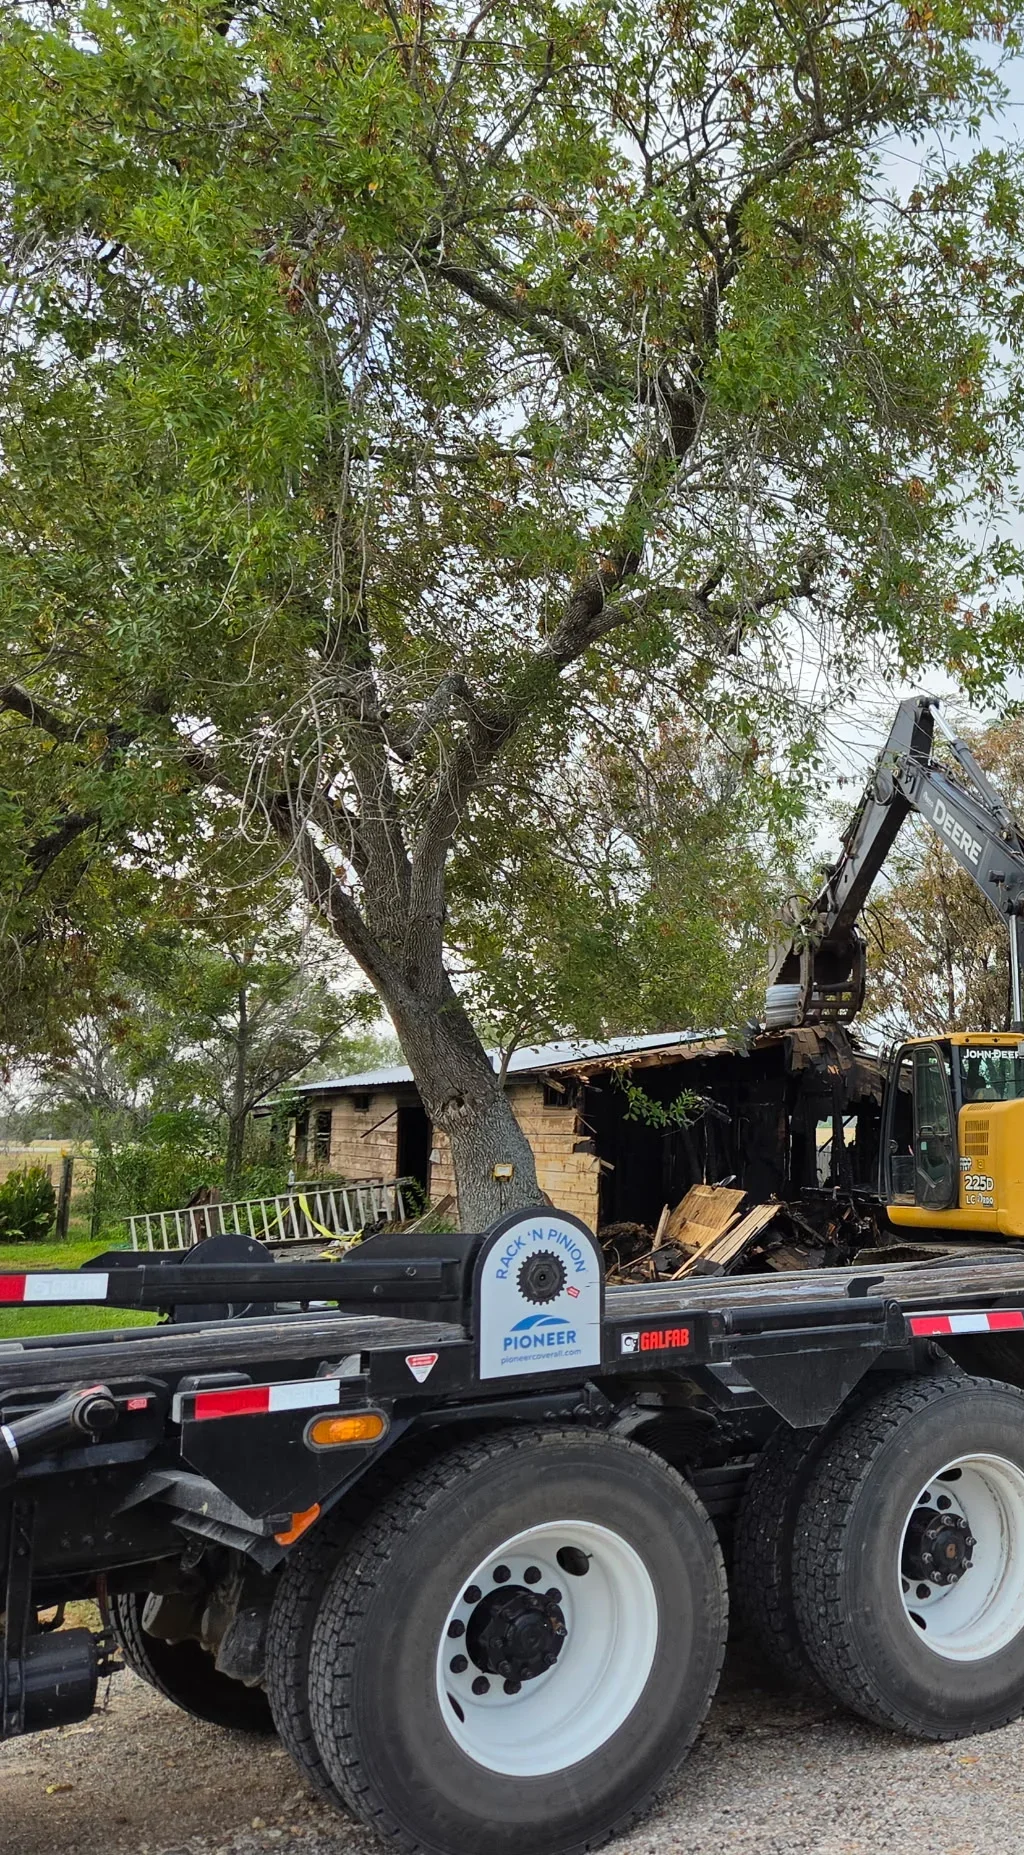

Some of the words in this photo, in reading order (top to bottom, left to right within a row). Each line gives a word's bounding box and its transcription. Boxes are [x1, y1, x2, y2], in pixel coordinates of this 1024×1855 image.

[933, 798, 982, 865] DEERE
[963, 1048, 992, 1059] JOHN
[964, 1174, 994, 1192] 225D
[966, 1195, 976, 1204] LC
[496, 1236, 526, 1279] RACK
[547, 1228, 586, 1273] PINION
[503, 1330, 577, 1351] PIONEER
[640, 1328, 689, 1351] GALFAB
[500, 1348, 582, 1365] pioneercoverall.com
